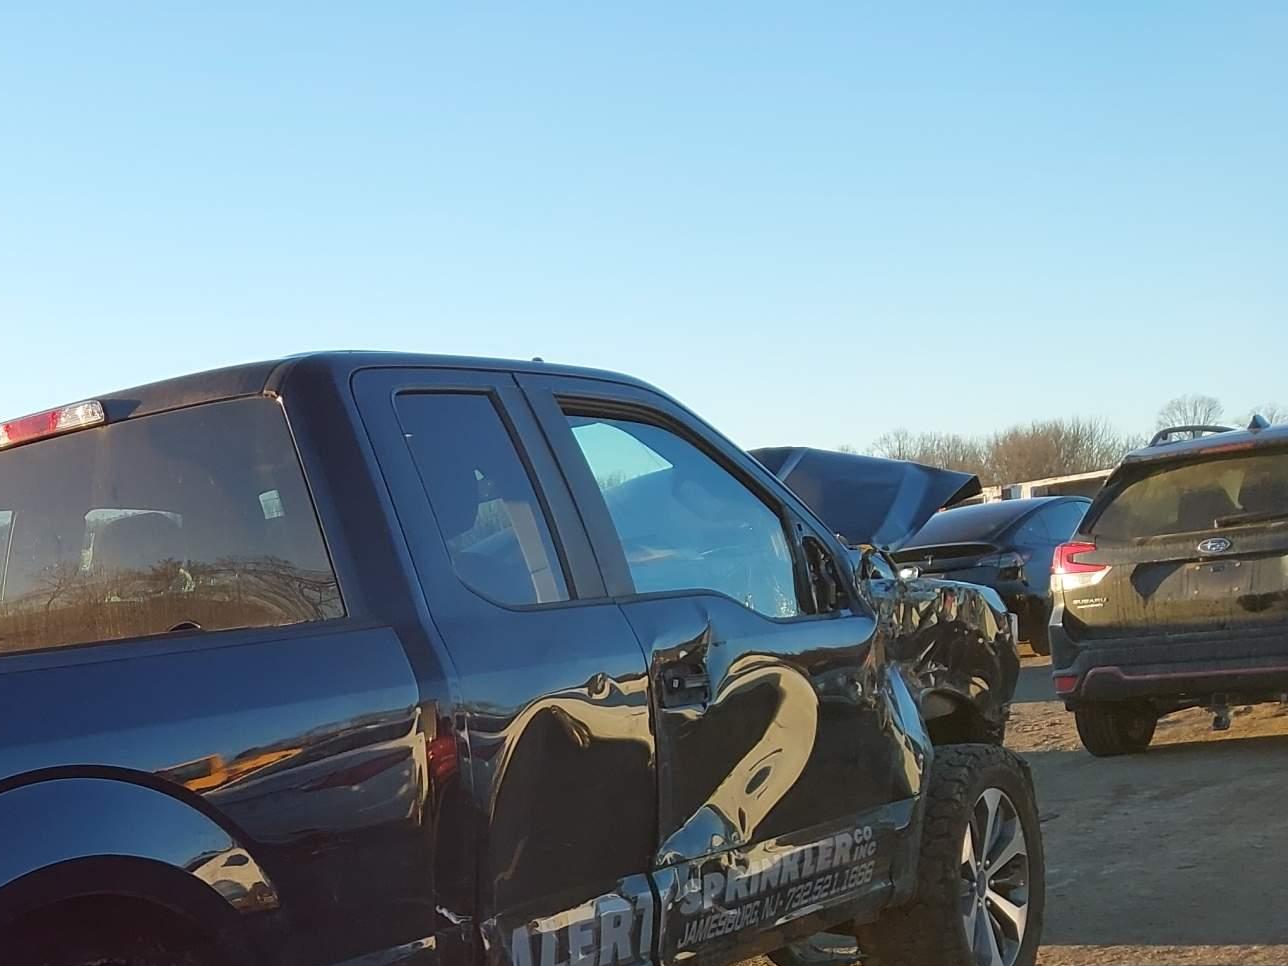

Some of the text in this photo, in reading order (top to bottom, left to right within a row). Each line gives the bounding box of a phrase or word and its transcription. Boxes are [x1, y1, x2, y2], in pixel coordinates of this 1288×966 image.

[854, 841, 877, 859] INC
[678, 832, 854, 914] SPRINKLER
[854, 826, 873, 842] CO
[761, 893, 779, 921] NJ
